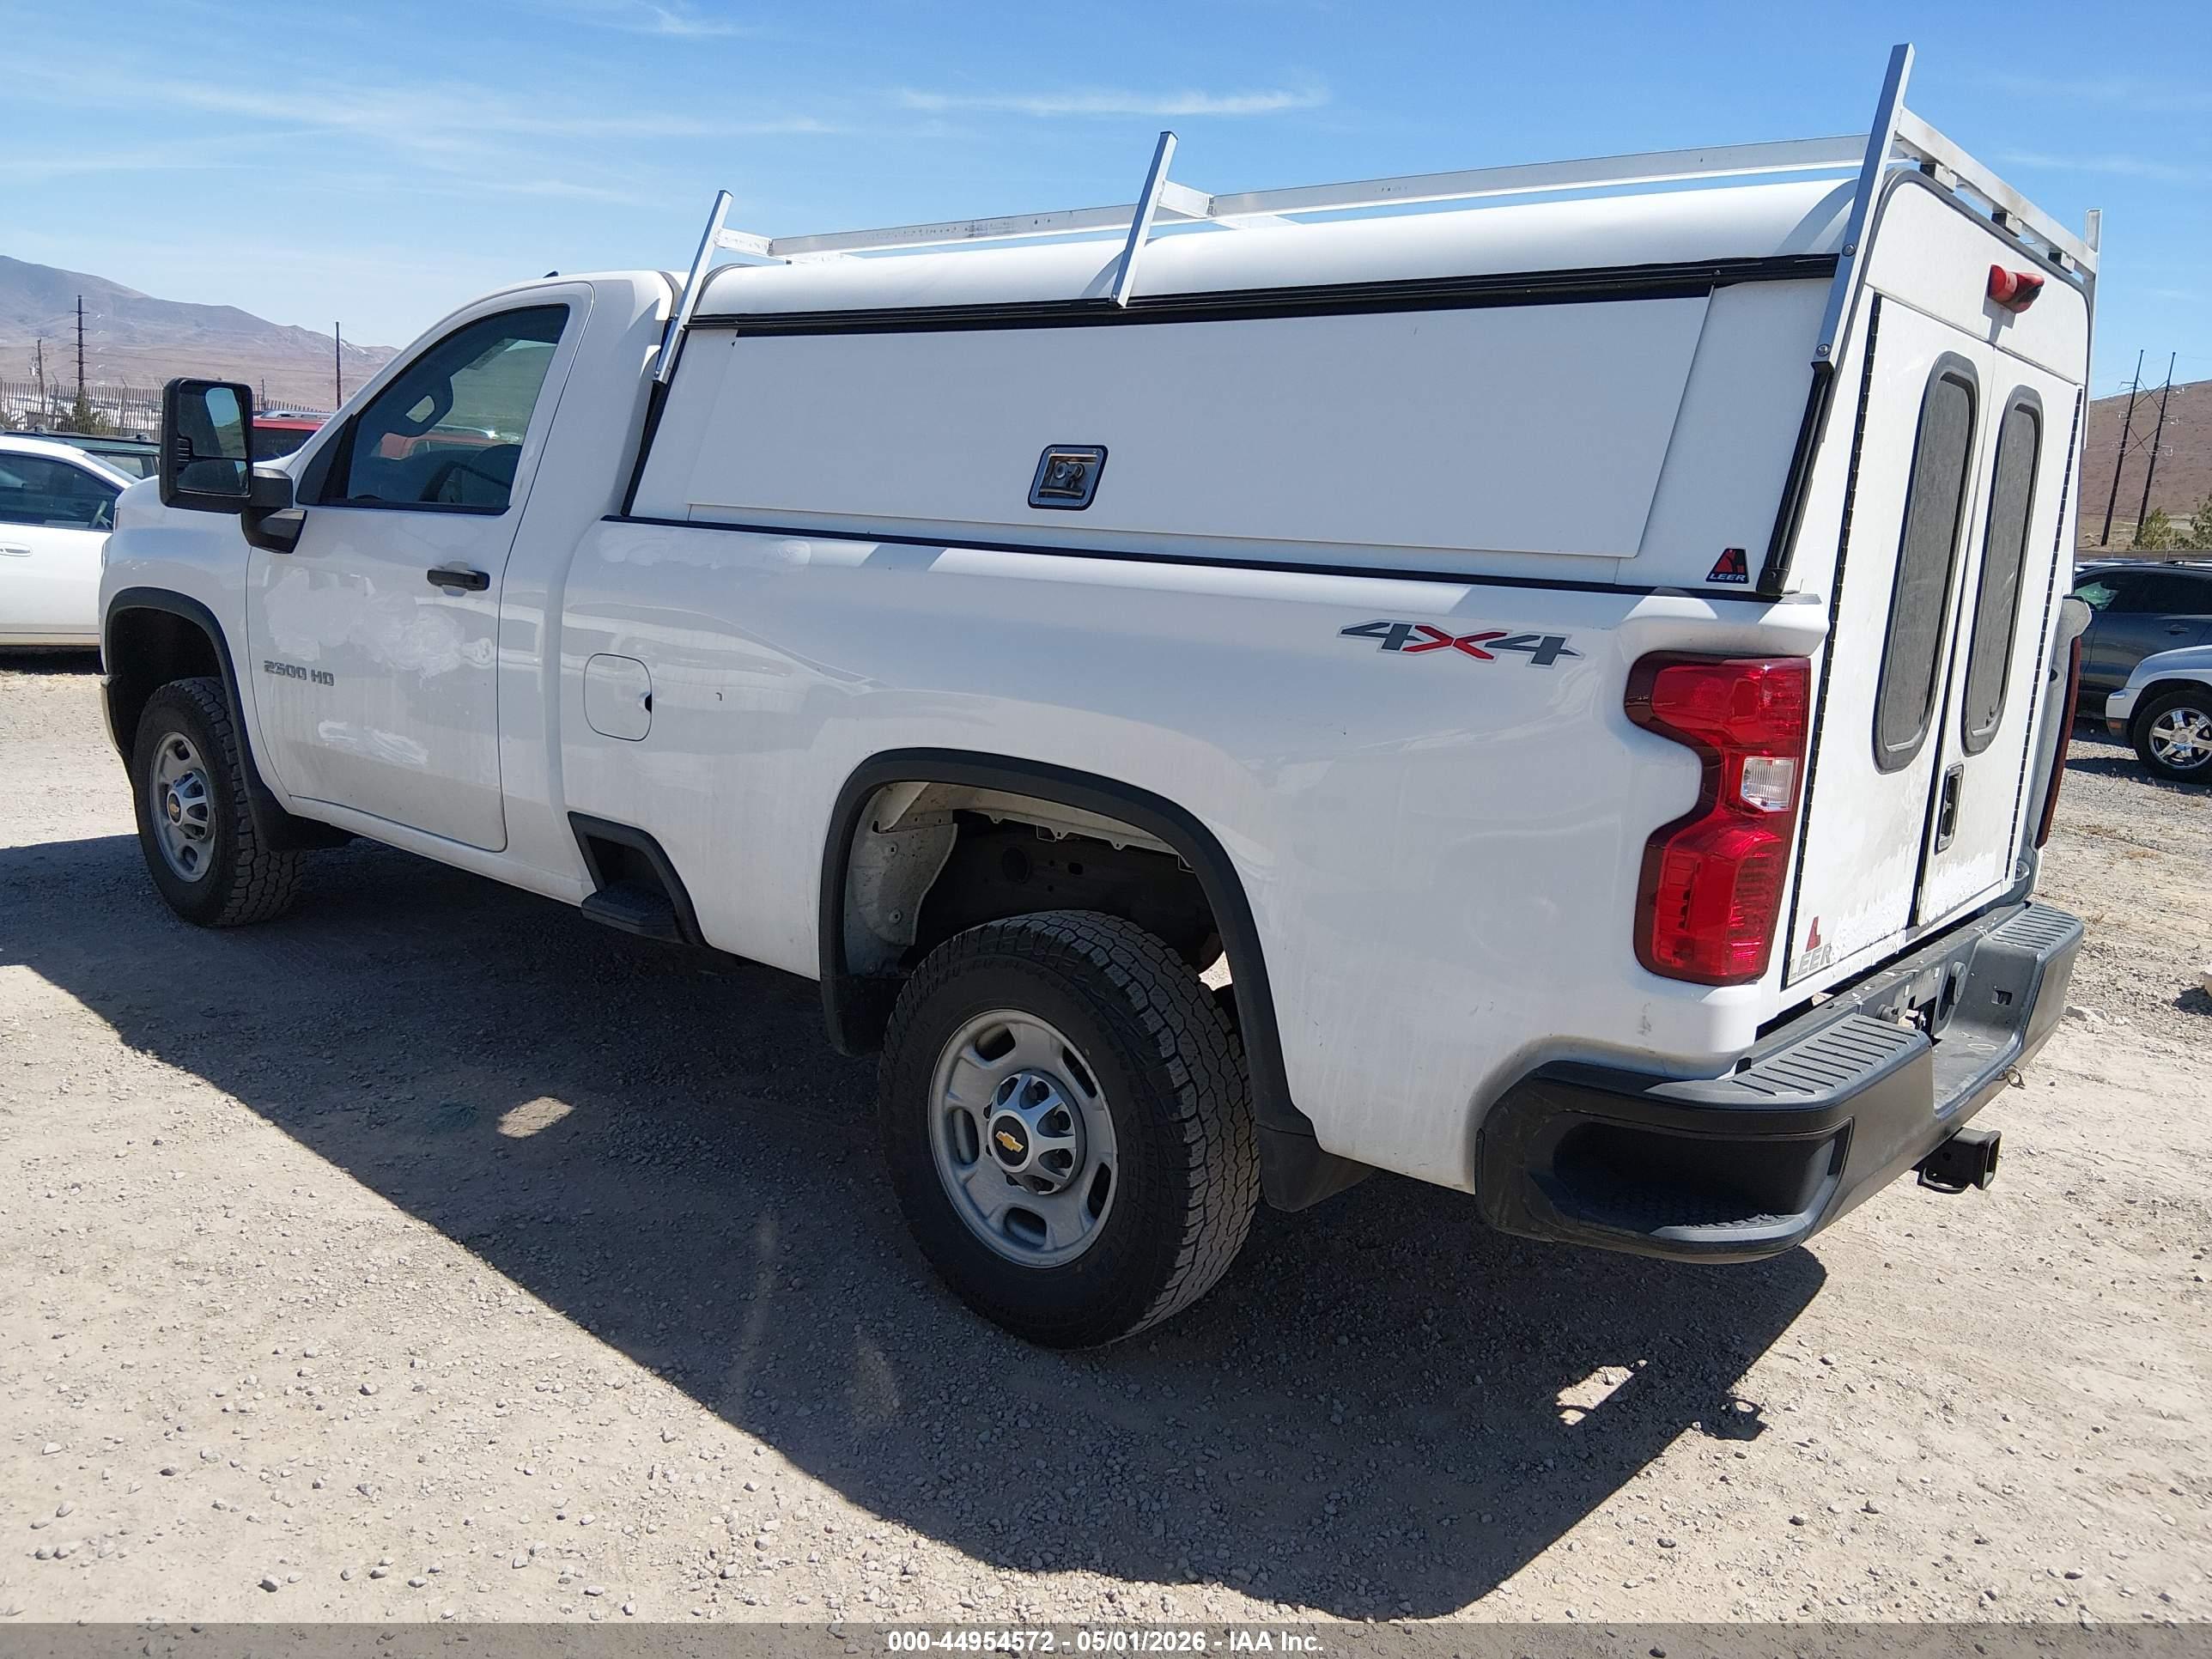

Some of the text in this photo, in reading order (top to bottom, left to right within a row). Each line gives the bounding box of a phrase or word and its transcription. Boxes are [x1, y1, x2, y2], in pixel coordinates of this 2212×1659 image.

[1709, 573, 1746, 581] LEER
[264, 660, 334, 686] 2500 HD
[1789, 942, 1832, 980] LEER
